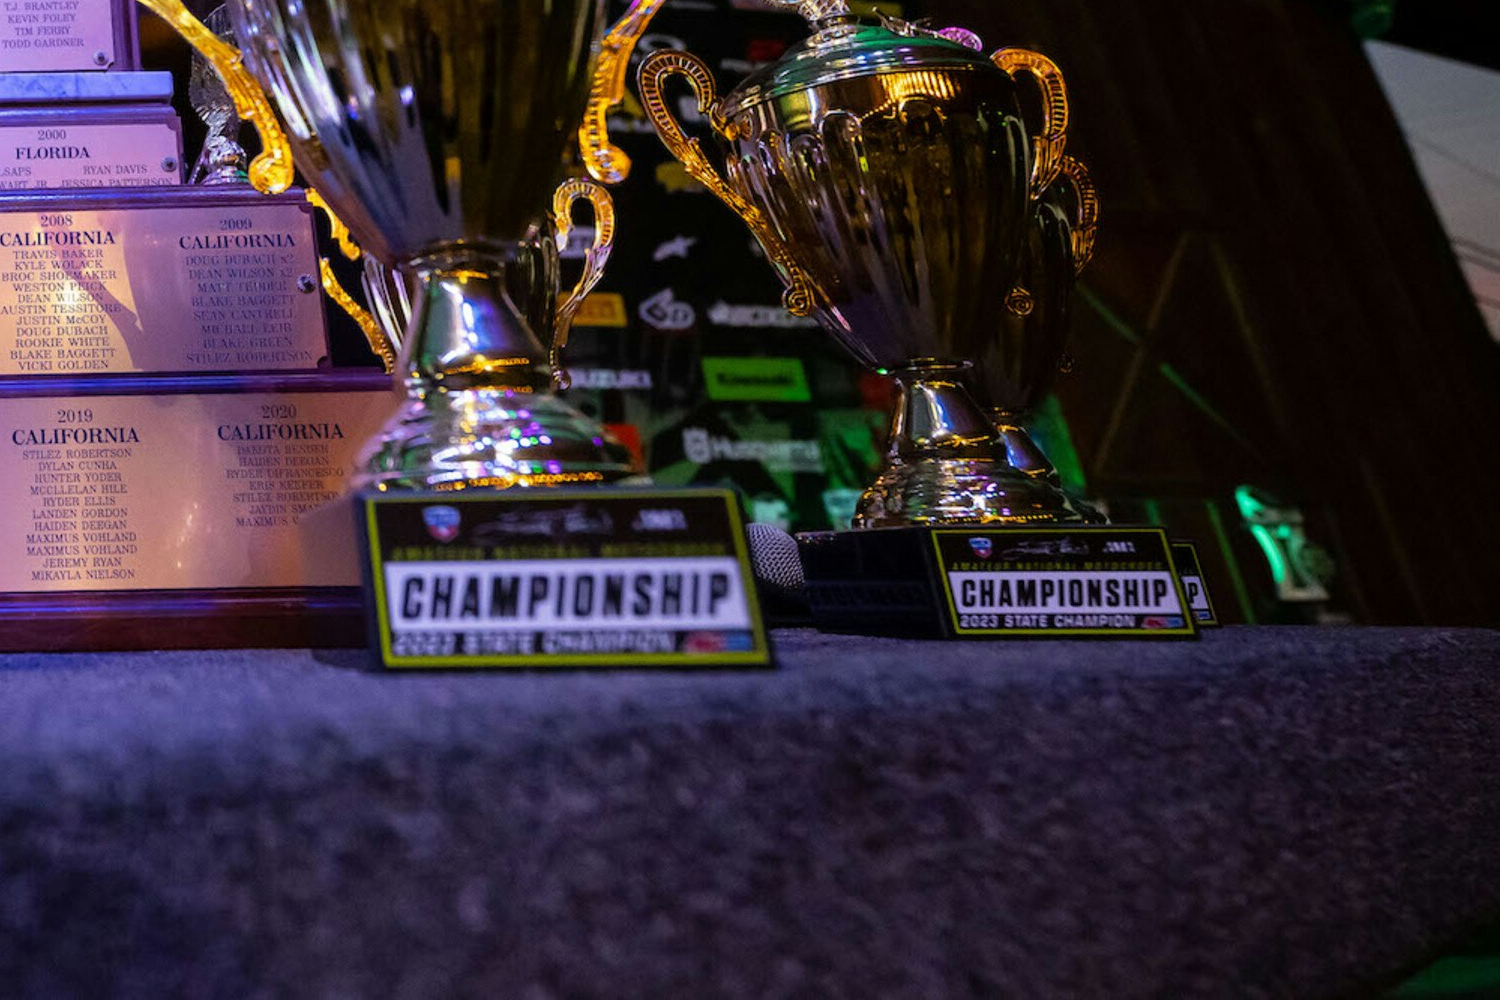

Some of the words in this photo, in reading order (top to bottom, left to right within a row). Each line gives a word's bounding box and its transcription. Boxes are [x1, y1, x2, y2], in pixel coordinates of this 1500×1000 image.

[8, 14, 39, 23] KEVIN
[43, 13, 76, 22] FOLEY
[15, 27, 33, 36] TIM
[37, 26, 70, 35] FERRY
[2, 40, 31, 48] TODD
[35, 38, 84, 47] GARDNER
[38, 130, 67, 141] 2000
[16, 147, 91, 160] FLORIDA
[83, 166, 112, 175] RYAN
[116, 165, 147, 174] DAVIS
[41, 215, 73, 227] 2008
[220, 218, 253, 230] 2009
[0, 231, 115, 247] CALIFORNIA
[179, 234, 295, 249] CALIFORNIA
[13, 250, 57, 259] TRAVIS
[62, 249, 103, 258] BAKER
[15, 261, 46, 270] KYLE
[51, 260, 103, 269] WOLACK
[2, 272, 34, 282] BROC
[40, 270, 117, 281] SHOEMAKER
[13, 283, 65, 292] WESTON
[70, 281, 106, 291] PEICK
[17, 294, 51, 303] DEAN
[56, 293, 103, 302] WILSON
[0, 305, 46, 315] AUSTIN
[51, 304, 121, 314] TESSITORE
[16, 316, 60, 326] JUSTIN
[66, 315, 107, 324] McCOY
[17, 327, 51, 337] DOUG
[57, 326, 108, 336] DUBACH
[16, 338, 63, 348] ROOKIE
[68, 337, 109, 347] WHITE
[10, 350, 51, 360] BLAKE
[57, 349, 116, 358] BAGGETT
[18, 361, 52, 371] VICKI
[58, 360, 109, 370] GOLDEN
[57, 409, 93, 423] 2019
[262, 404, 297, 418] 2020
[12, 427, 140, 445] CALIFORNIA
[218, 423, 344, 441] CALIFORNIA
[22, 450, 62, 460] STILEZ
[66, 449, 132, 459] ROBERTSON
[38, 462, 74, 471] DYLAN
[78, 461, 117, 470] CUNHA
[34, 474, 80, 484] HUNTER
[85, 472, 122, 482] YODER
[43, 498, 80, 507] RYDER
[84, 497, 116, 506] ELLIS
[32, 510, 77, 519] LANDEN
[81, 508, 128, 518] GORDON
[34, 522, 77, 531] HAIDEN
[81, 520, 127, 530] DEEGAN
[26, 534, 79, 544] MAXIMUS
[83, 532, 137, 542] VOHLAND
[27, 546, 80, 556] MAXIMUS
[84, 544, 138, 554] VOHLAND
[42, 558, 88, 569] JEREMY
[93, 557, 122, 566] RYAN
[31, 571, 81, 581] MIKAYLA
[86, 569, 135, 579] NIELSON
[403, 572, 730, 619] CHAMPIONSHIP
[961, 579, 1168, 608] CHAMPIONSHIP
[959, 614, 999, 628] 2023
[1004, 614, 1048, 627] STATE
[1054, 614, 1136, 627] CHAMPION
